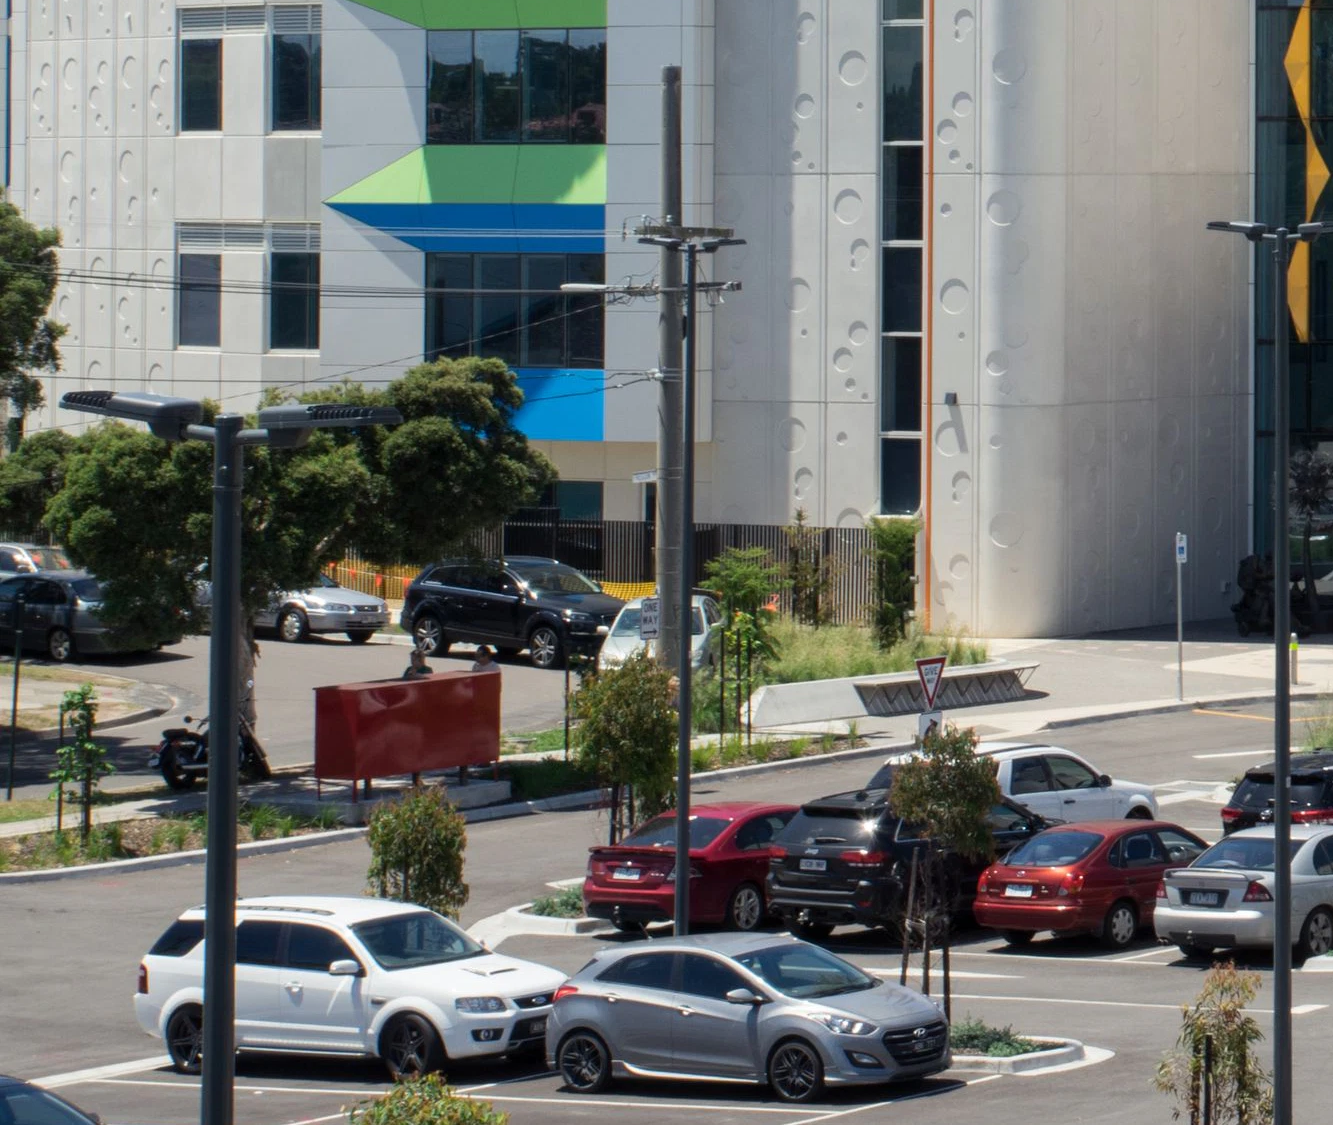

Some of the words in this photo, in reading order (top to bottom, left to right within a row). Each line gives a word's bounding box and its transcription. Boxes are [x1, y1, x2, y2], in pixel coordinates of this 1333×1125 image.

[643, 602, 658, 613] ONE
[643, 616, 658, 625] WAY
[924, 665, 938, 677] GIVE
